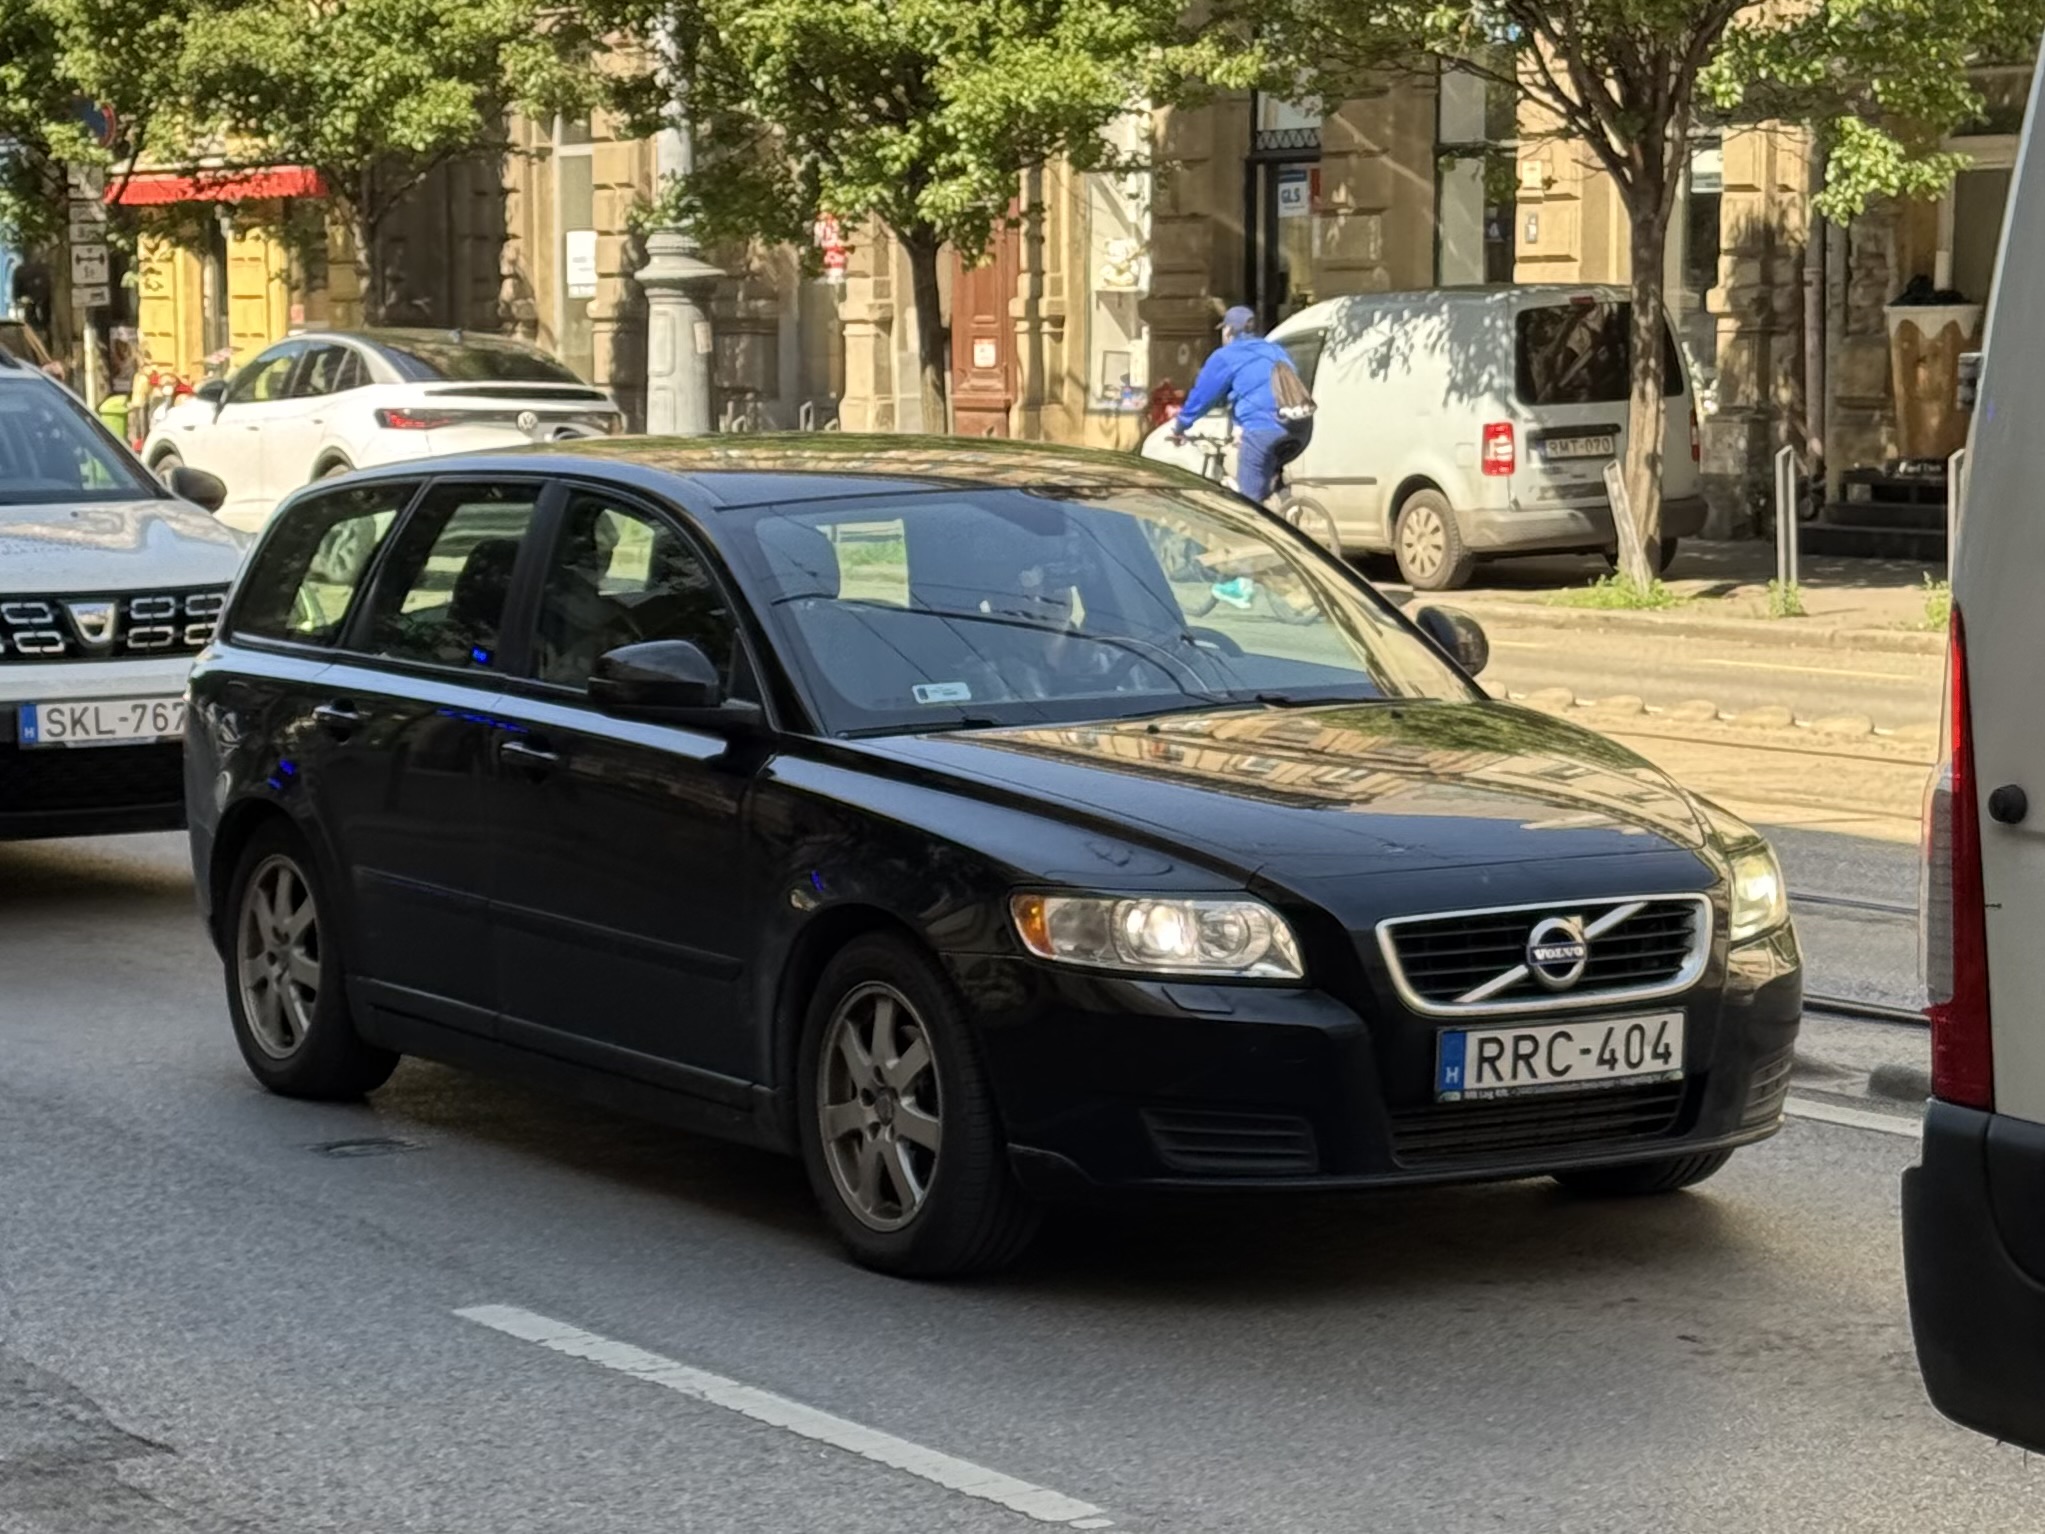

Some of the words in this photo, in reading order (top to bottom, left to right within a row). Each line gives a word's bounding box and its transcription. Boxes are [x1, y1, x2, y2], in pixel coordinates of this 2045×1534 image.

[45, 702, 186, 738] SKL-767
[24, 727, 35, 738] H
[1534, 946, 1584, 960] VOLVO
[1475, 1020, 1672, 1084] RRC-404
[1445, 1066, 1459, 1084] H
